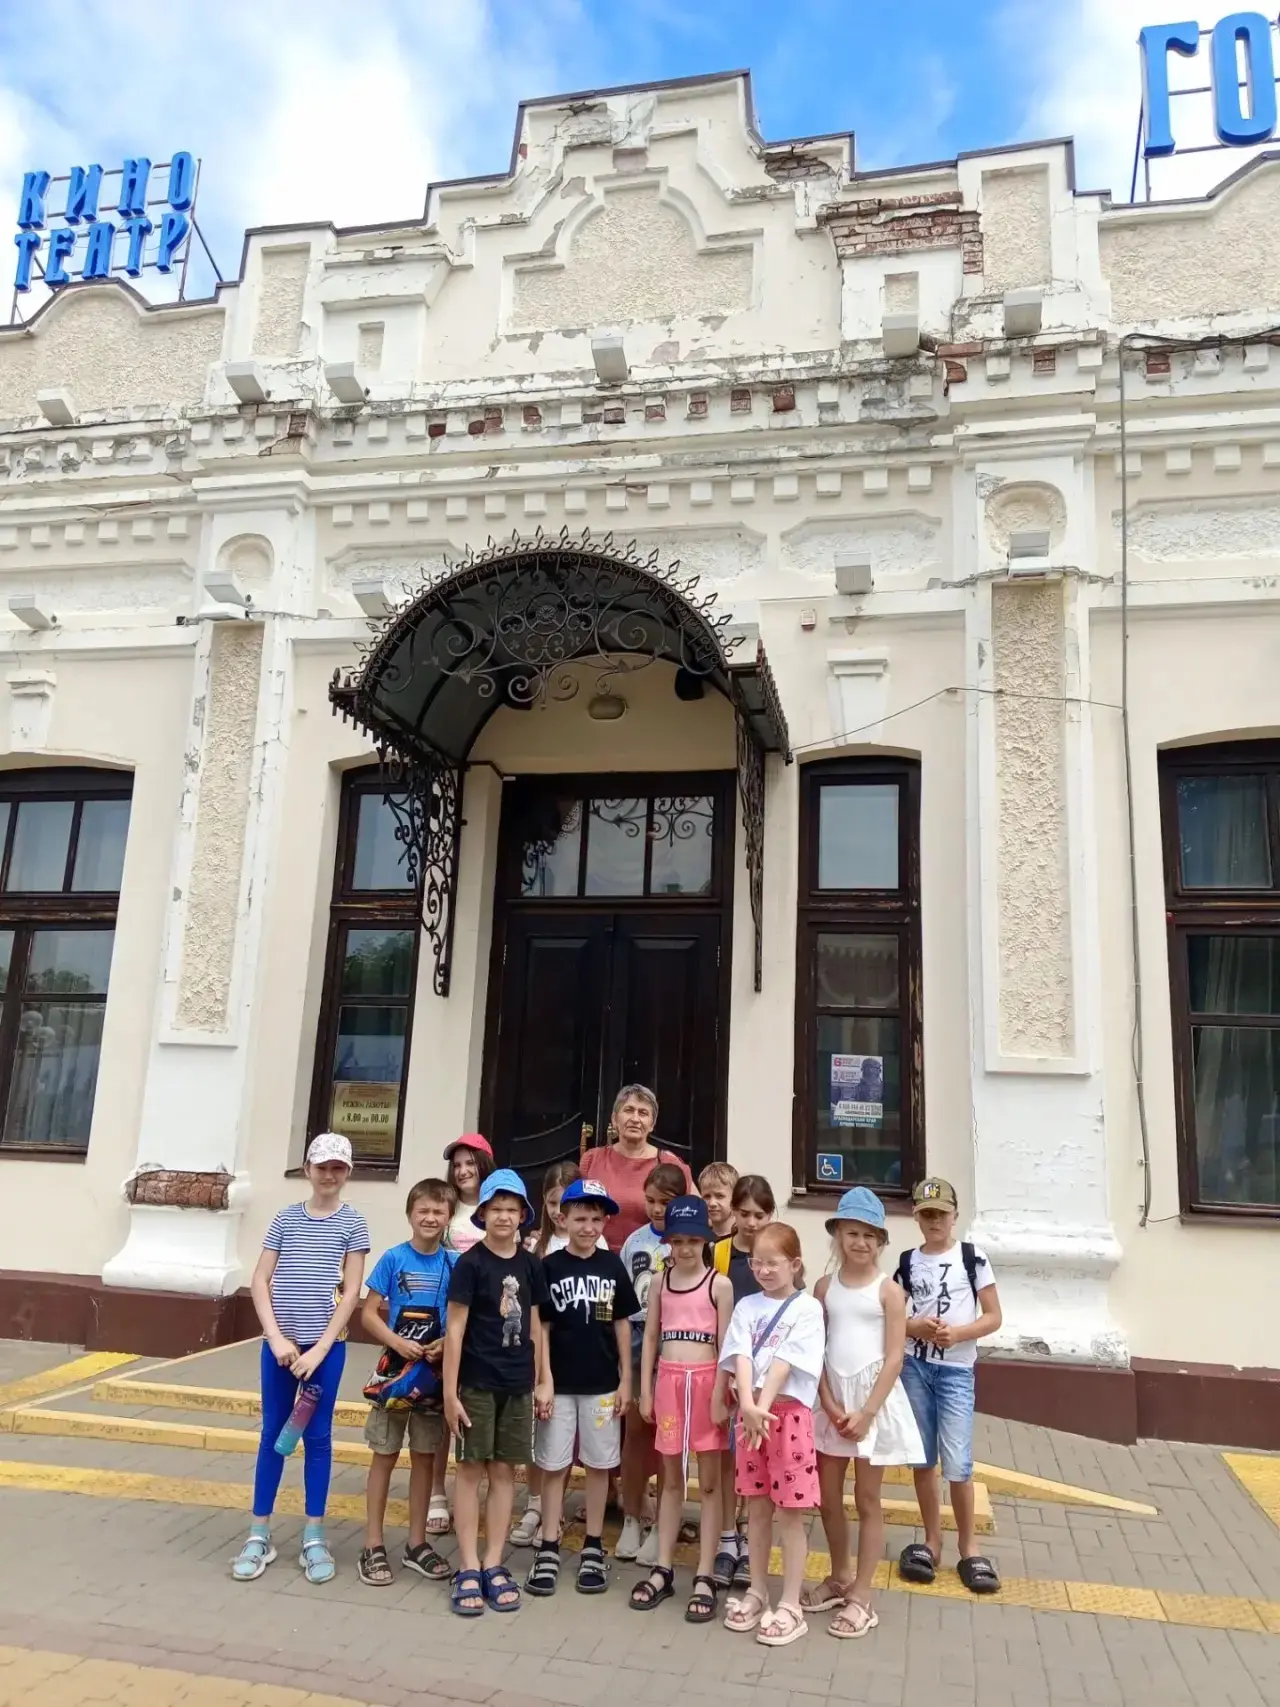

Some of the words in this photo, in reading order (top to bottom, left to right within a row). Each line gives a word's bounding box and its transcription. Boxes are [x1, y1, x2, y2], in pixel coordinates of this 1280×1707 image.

[18, 151, 196, 229] КИНО
[14, 212, 190, 291] ТЕАТР
[550, 1275, 616, 1314] CHANGE
